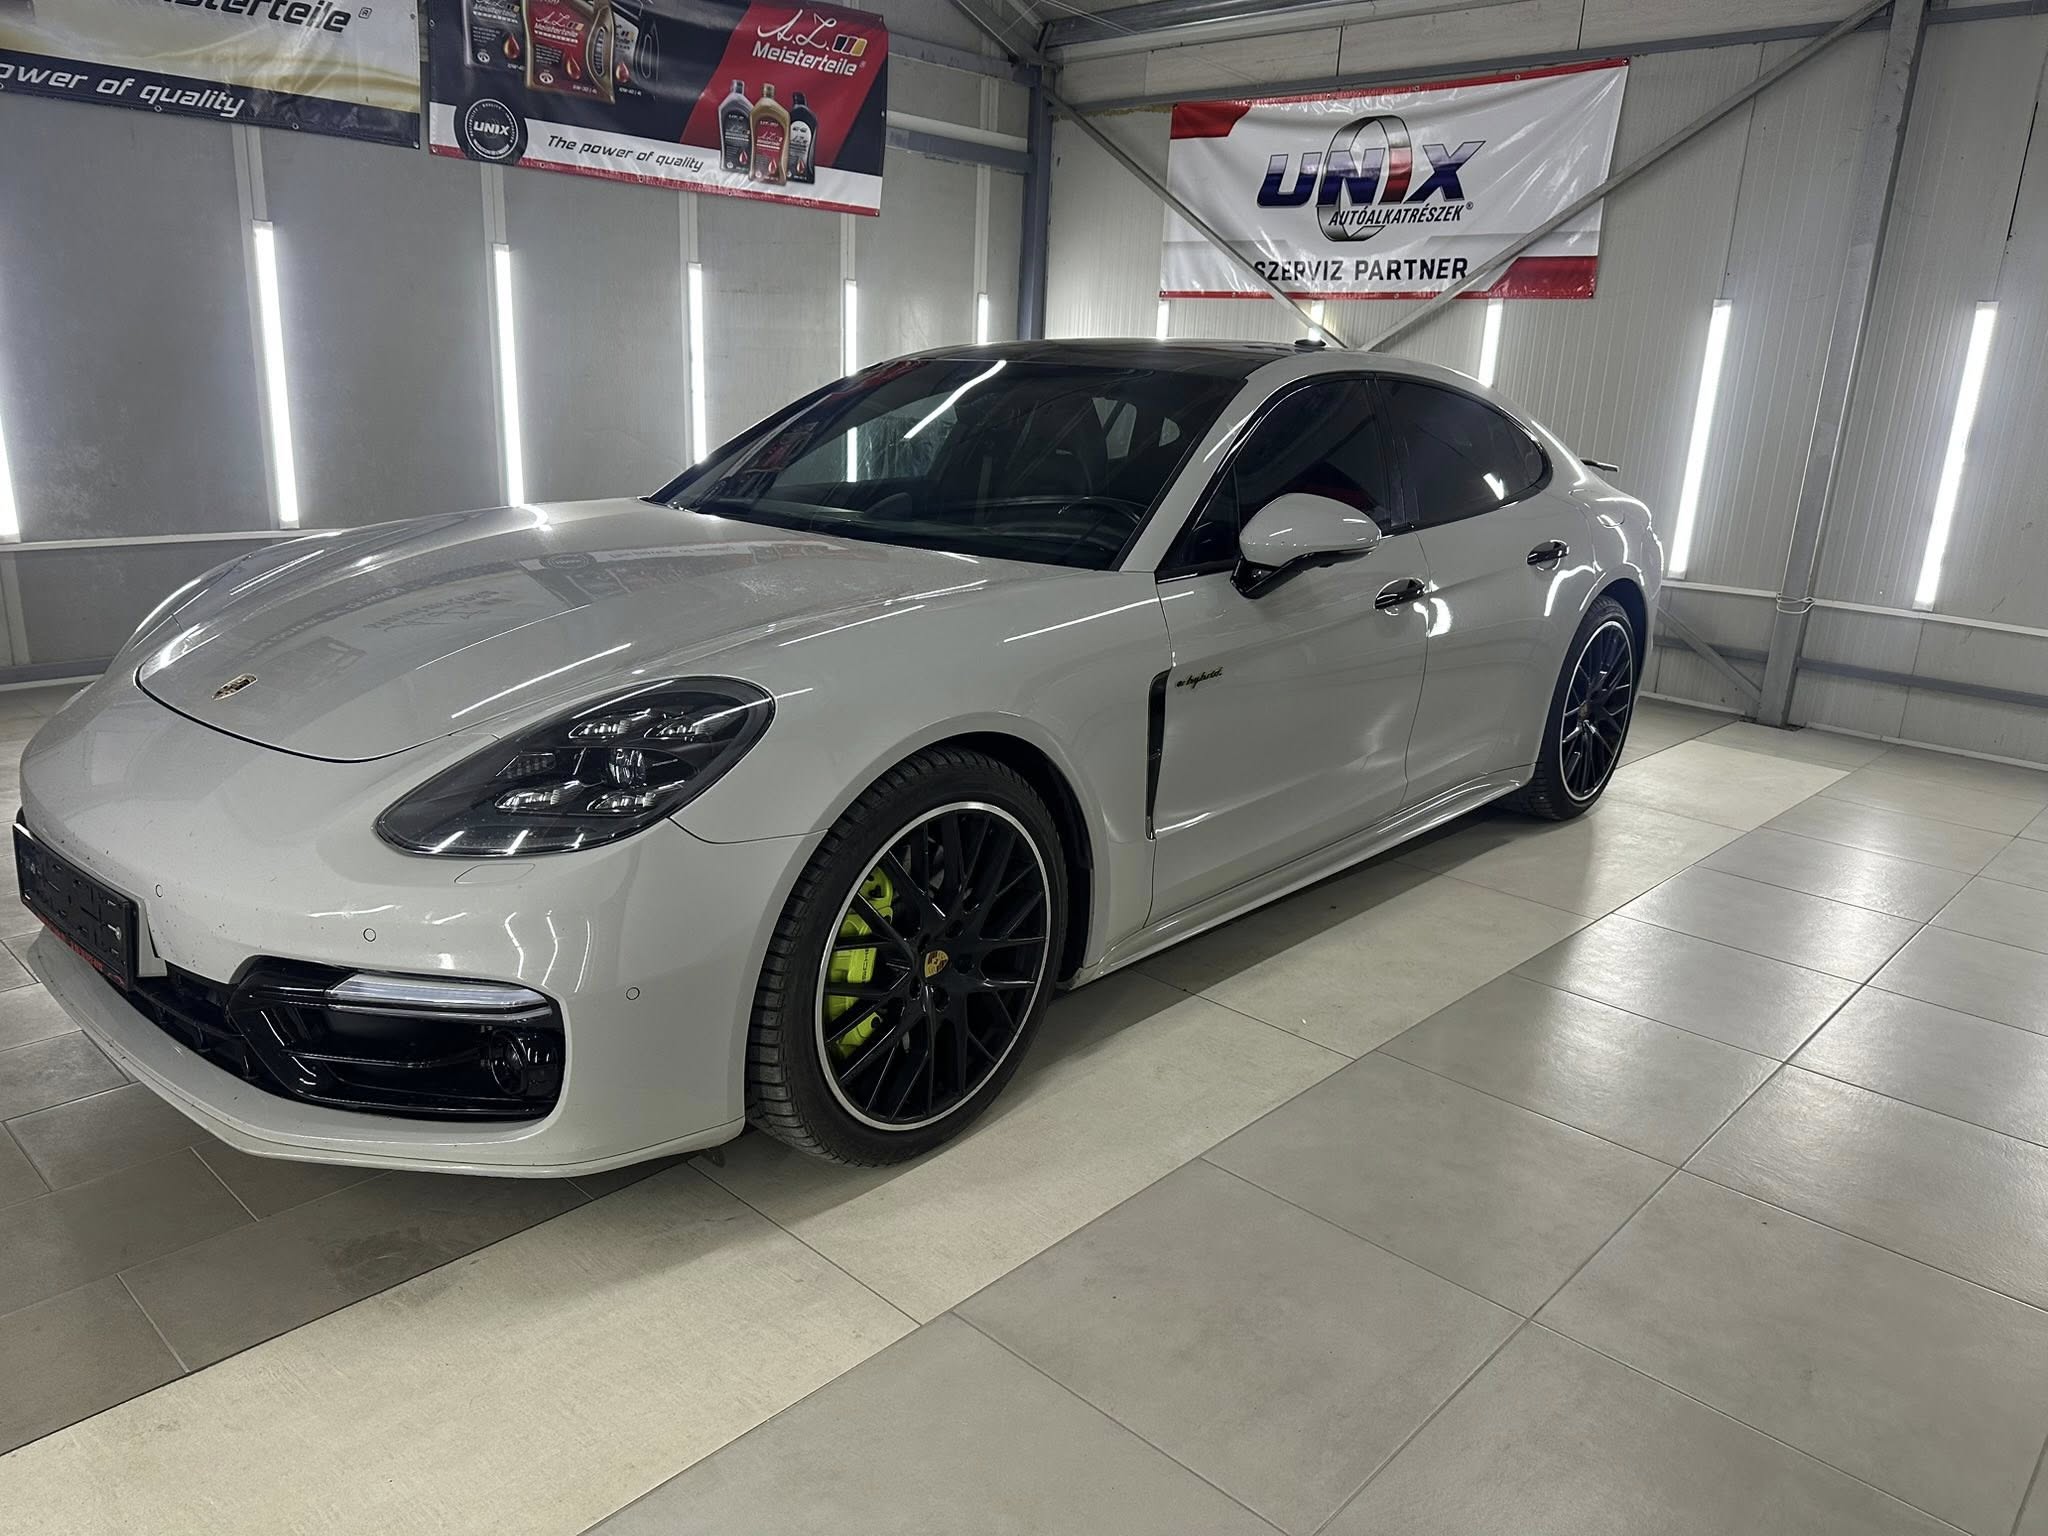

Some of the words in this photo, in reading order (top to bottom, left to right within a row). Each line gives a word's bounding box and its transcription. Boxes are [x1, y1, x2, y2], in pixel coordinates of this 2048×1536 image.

[752, 40, 858, 76] Meisterteile
[96, 78, 135, 95] of
[139, 85, 245, 118] quality
[473, 121, 510, 136] UNIX
[547, 135, 577, 150] The
[579, 142, 633, 159] power
[636, 151, 654, 162] of
[655, 153, 704, 173] quality
[1257, 140, 1487, 208] UNIX
[1254, 260, 1344, 281] SZERVIZ
[1354, 257, 1468, 280] PARTNER
